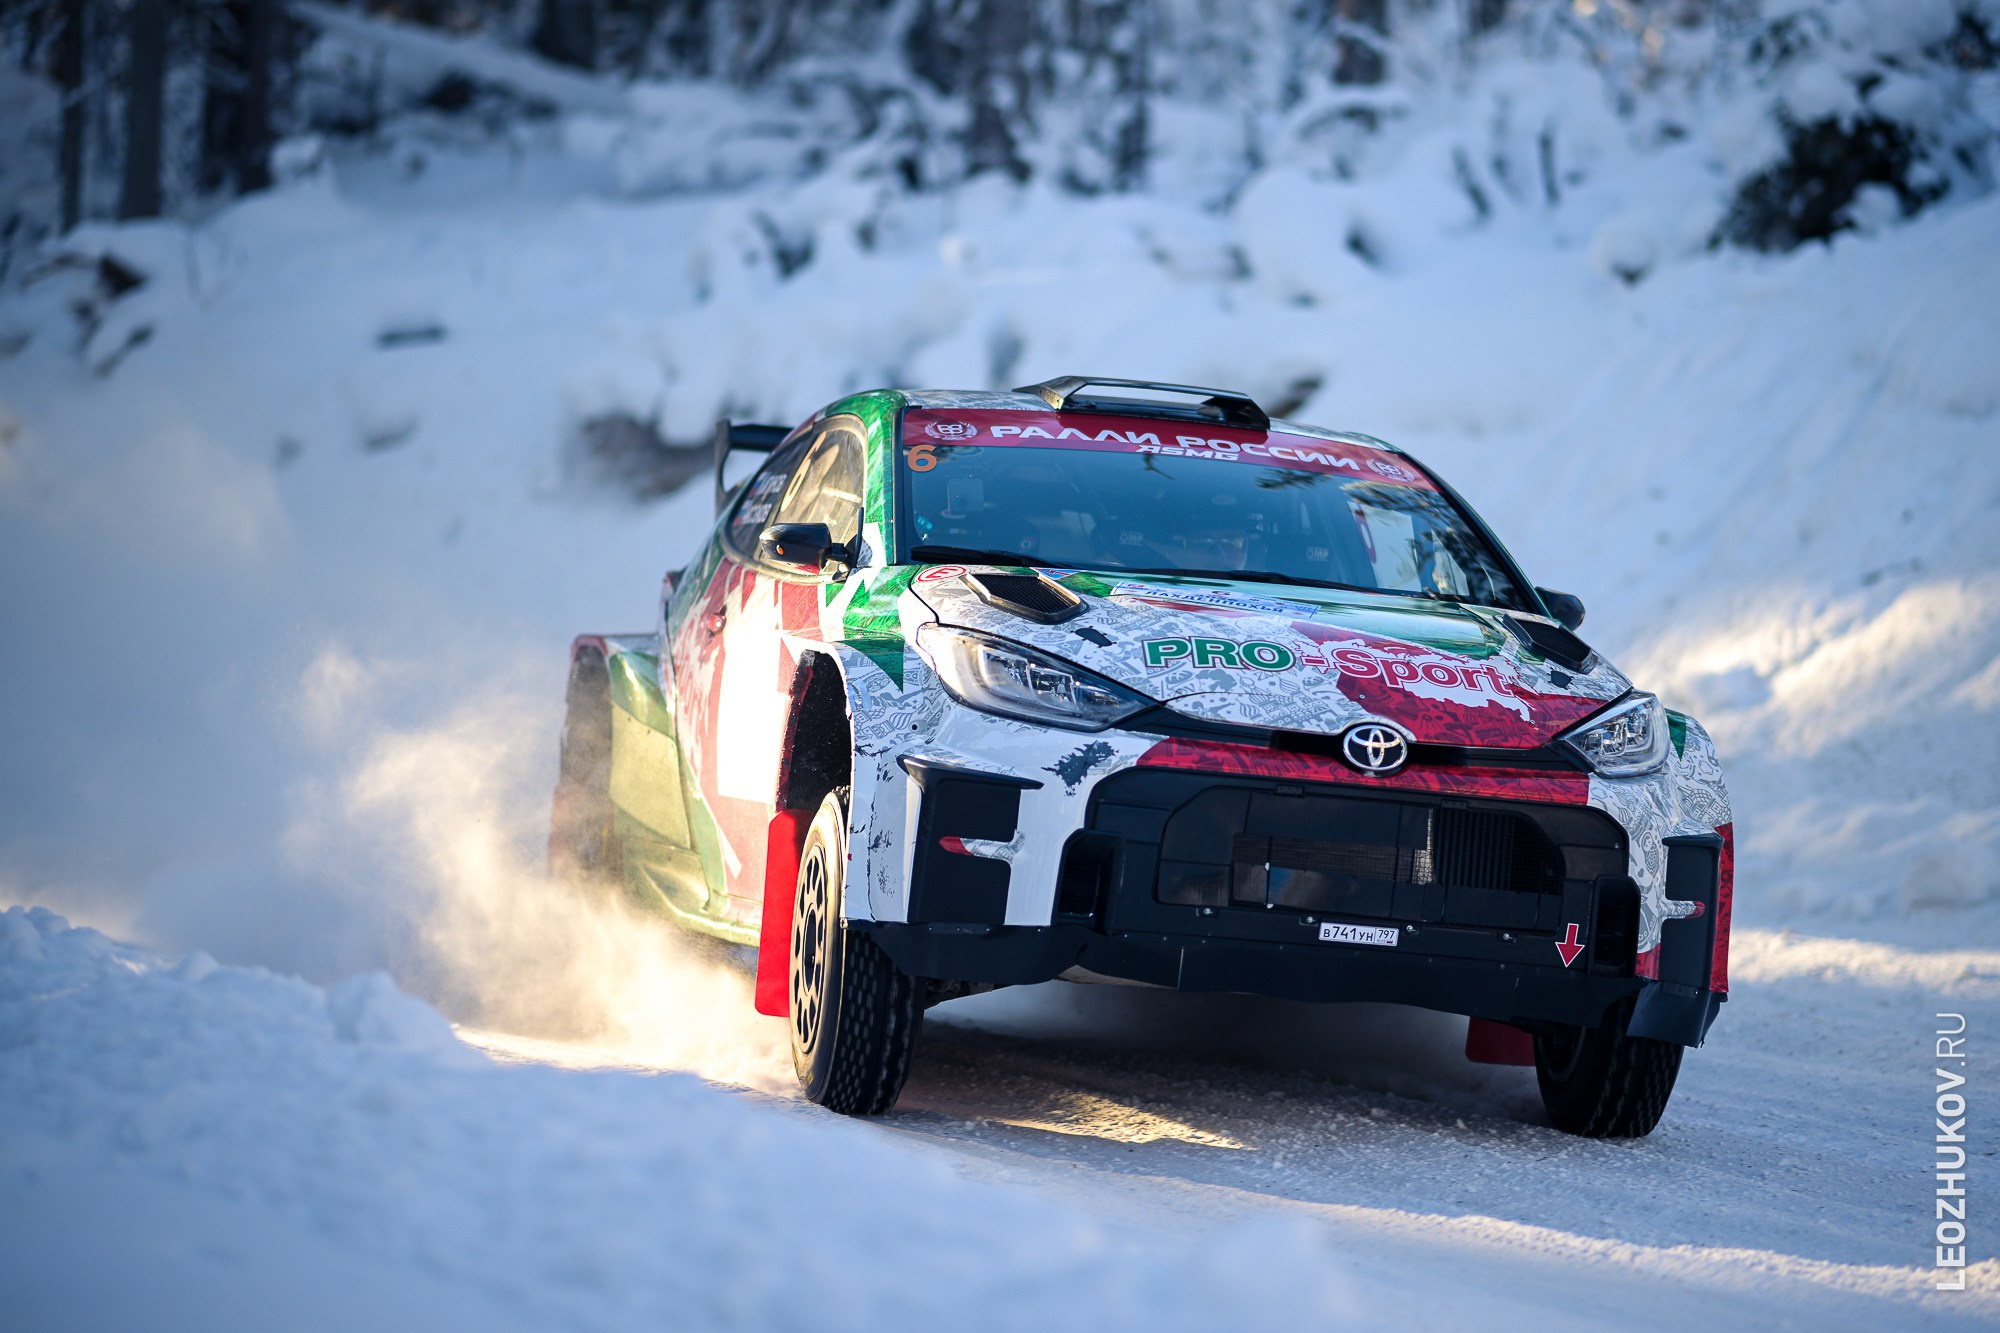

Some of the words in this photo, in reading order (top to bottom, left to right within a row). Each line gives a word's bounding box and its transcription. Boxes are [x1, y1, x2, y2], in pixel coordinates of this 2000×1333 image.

[907, 445, 937, 472] 6
[990, 426, 1161, 445] РАЛЛИ
[1176, 436, 1360, 470] РОССИИ
[1378, 929, 1395, 939] 797
